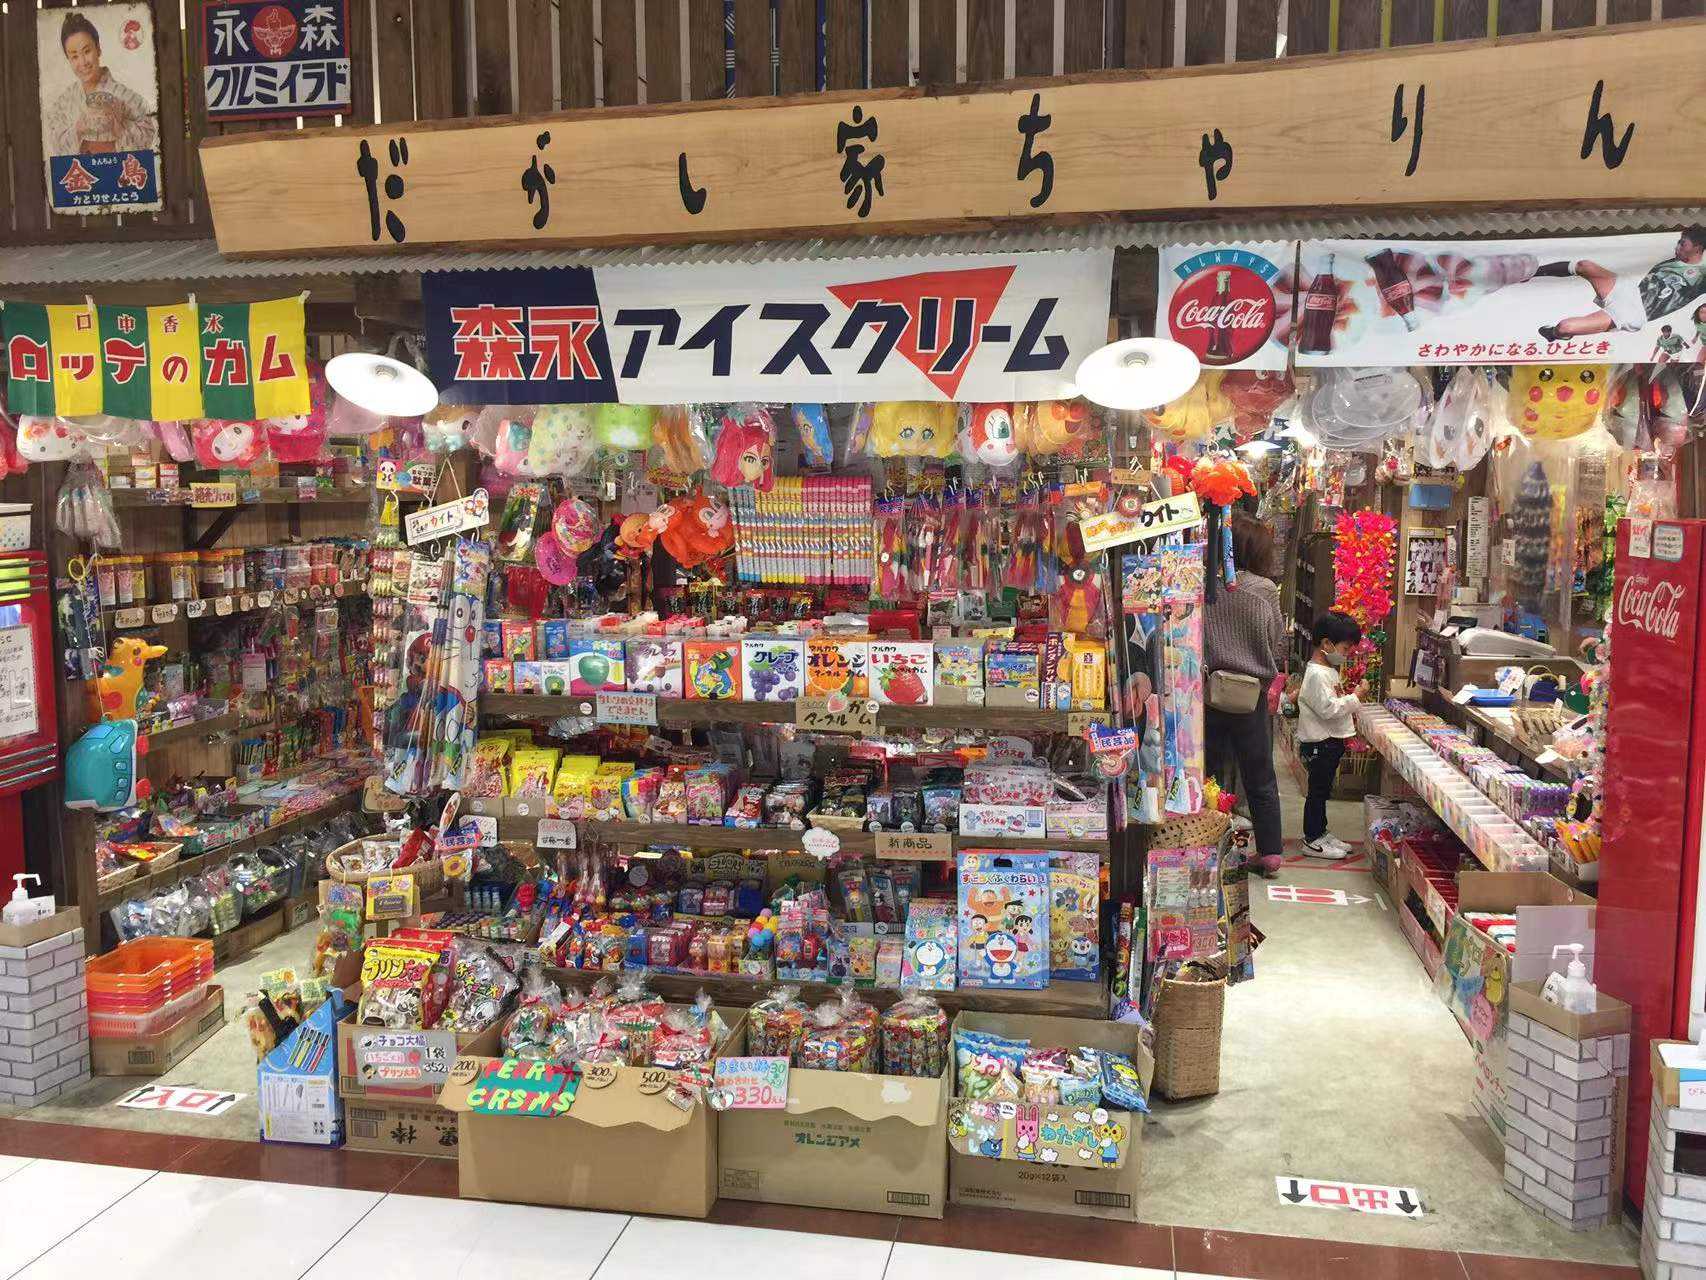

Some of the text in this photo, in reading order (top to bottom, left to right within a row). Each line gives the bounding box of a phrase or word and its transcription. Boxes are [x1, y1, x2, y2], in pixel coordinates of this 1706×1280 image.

[300, 4, 341, 52] 森
[1183, 254, 1269, 275] ALWAYS
[75, 312, 225, 335] 口中香水
[1175, 297, 1267, 330] Coca-Cola
[8, 334, 297, 385] ロッテのガム
[1618, 575, 1687, 639] Coca-Cola
[753, 649, 800, 664] グレープ
[806, 653, 867, 668] オレンジ
[870, 653, 929, 665] いちご
[888, 837, 933, 850] 新商品
